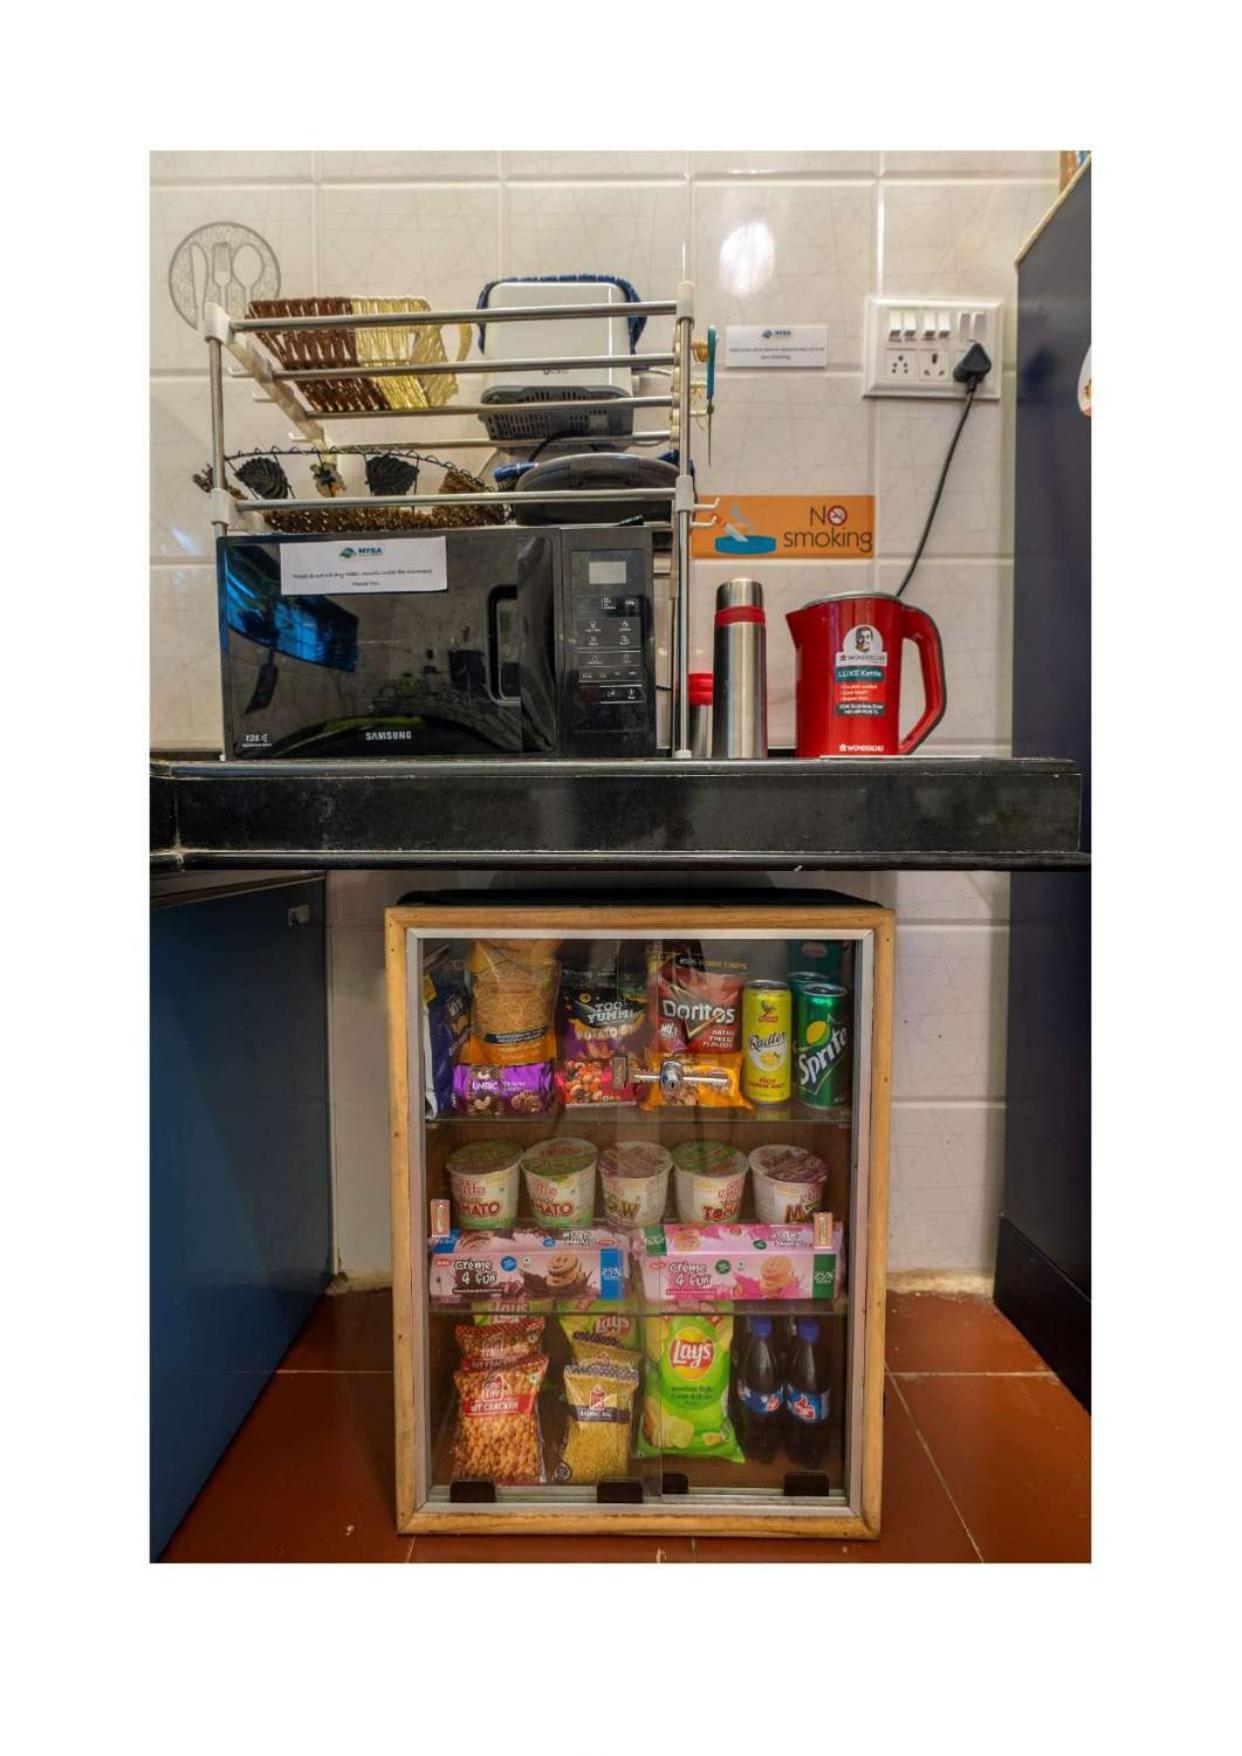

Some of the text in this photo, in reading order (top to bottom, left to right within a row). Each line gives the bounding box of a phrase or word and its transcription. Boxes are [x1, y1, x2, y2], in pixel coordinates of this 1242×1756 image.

[809, 505, 848, 526] NO
[783, 526, 873, 553] smoking
[365, 731, 412, 741] SAMSUNG
[662, 999, 737, 1025] Doritos
[747, 1032, 786, 1053] Radler
[799, 1027, 848, 1086] Sprite
[461, 1274, 470, 1285] 4
[672, 1338, 713, 1369] Lay's
